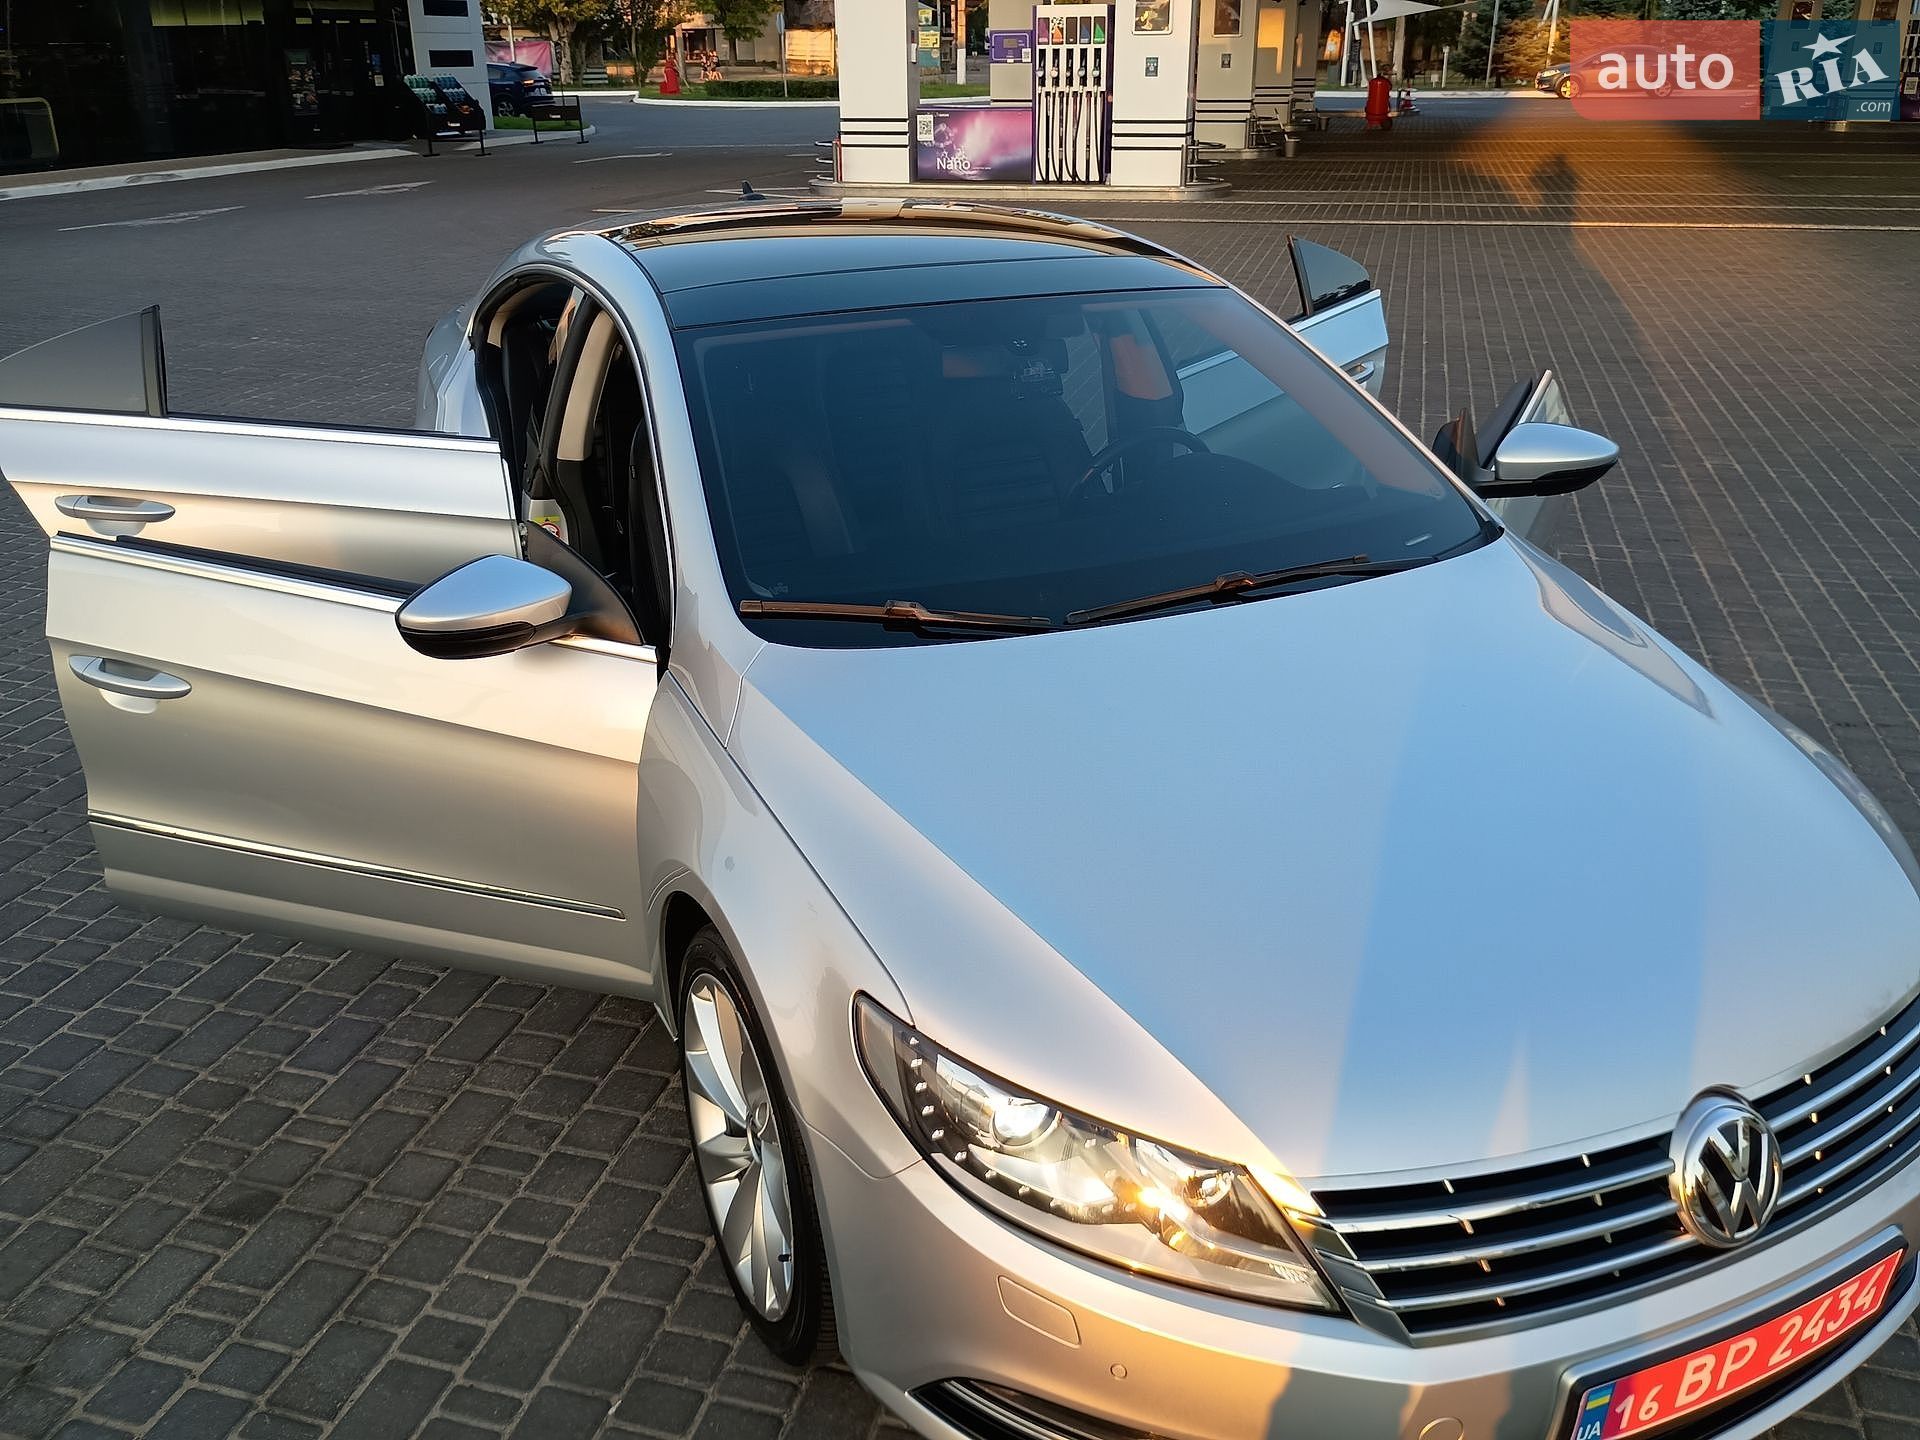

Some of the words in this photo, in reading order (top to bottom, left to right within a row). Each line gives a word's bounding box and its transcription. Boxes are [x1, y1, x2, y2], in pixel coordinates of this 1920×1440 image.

[937, 158, 971, 170] Nano
[1615, 1384, 1664, 1430] 16
[1675, 1337, 1758, 1408] BP
[1768, 1266, 1885, 1367] 2434
[1576, 1420, 1601, 1440] UA
